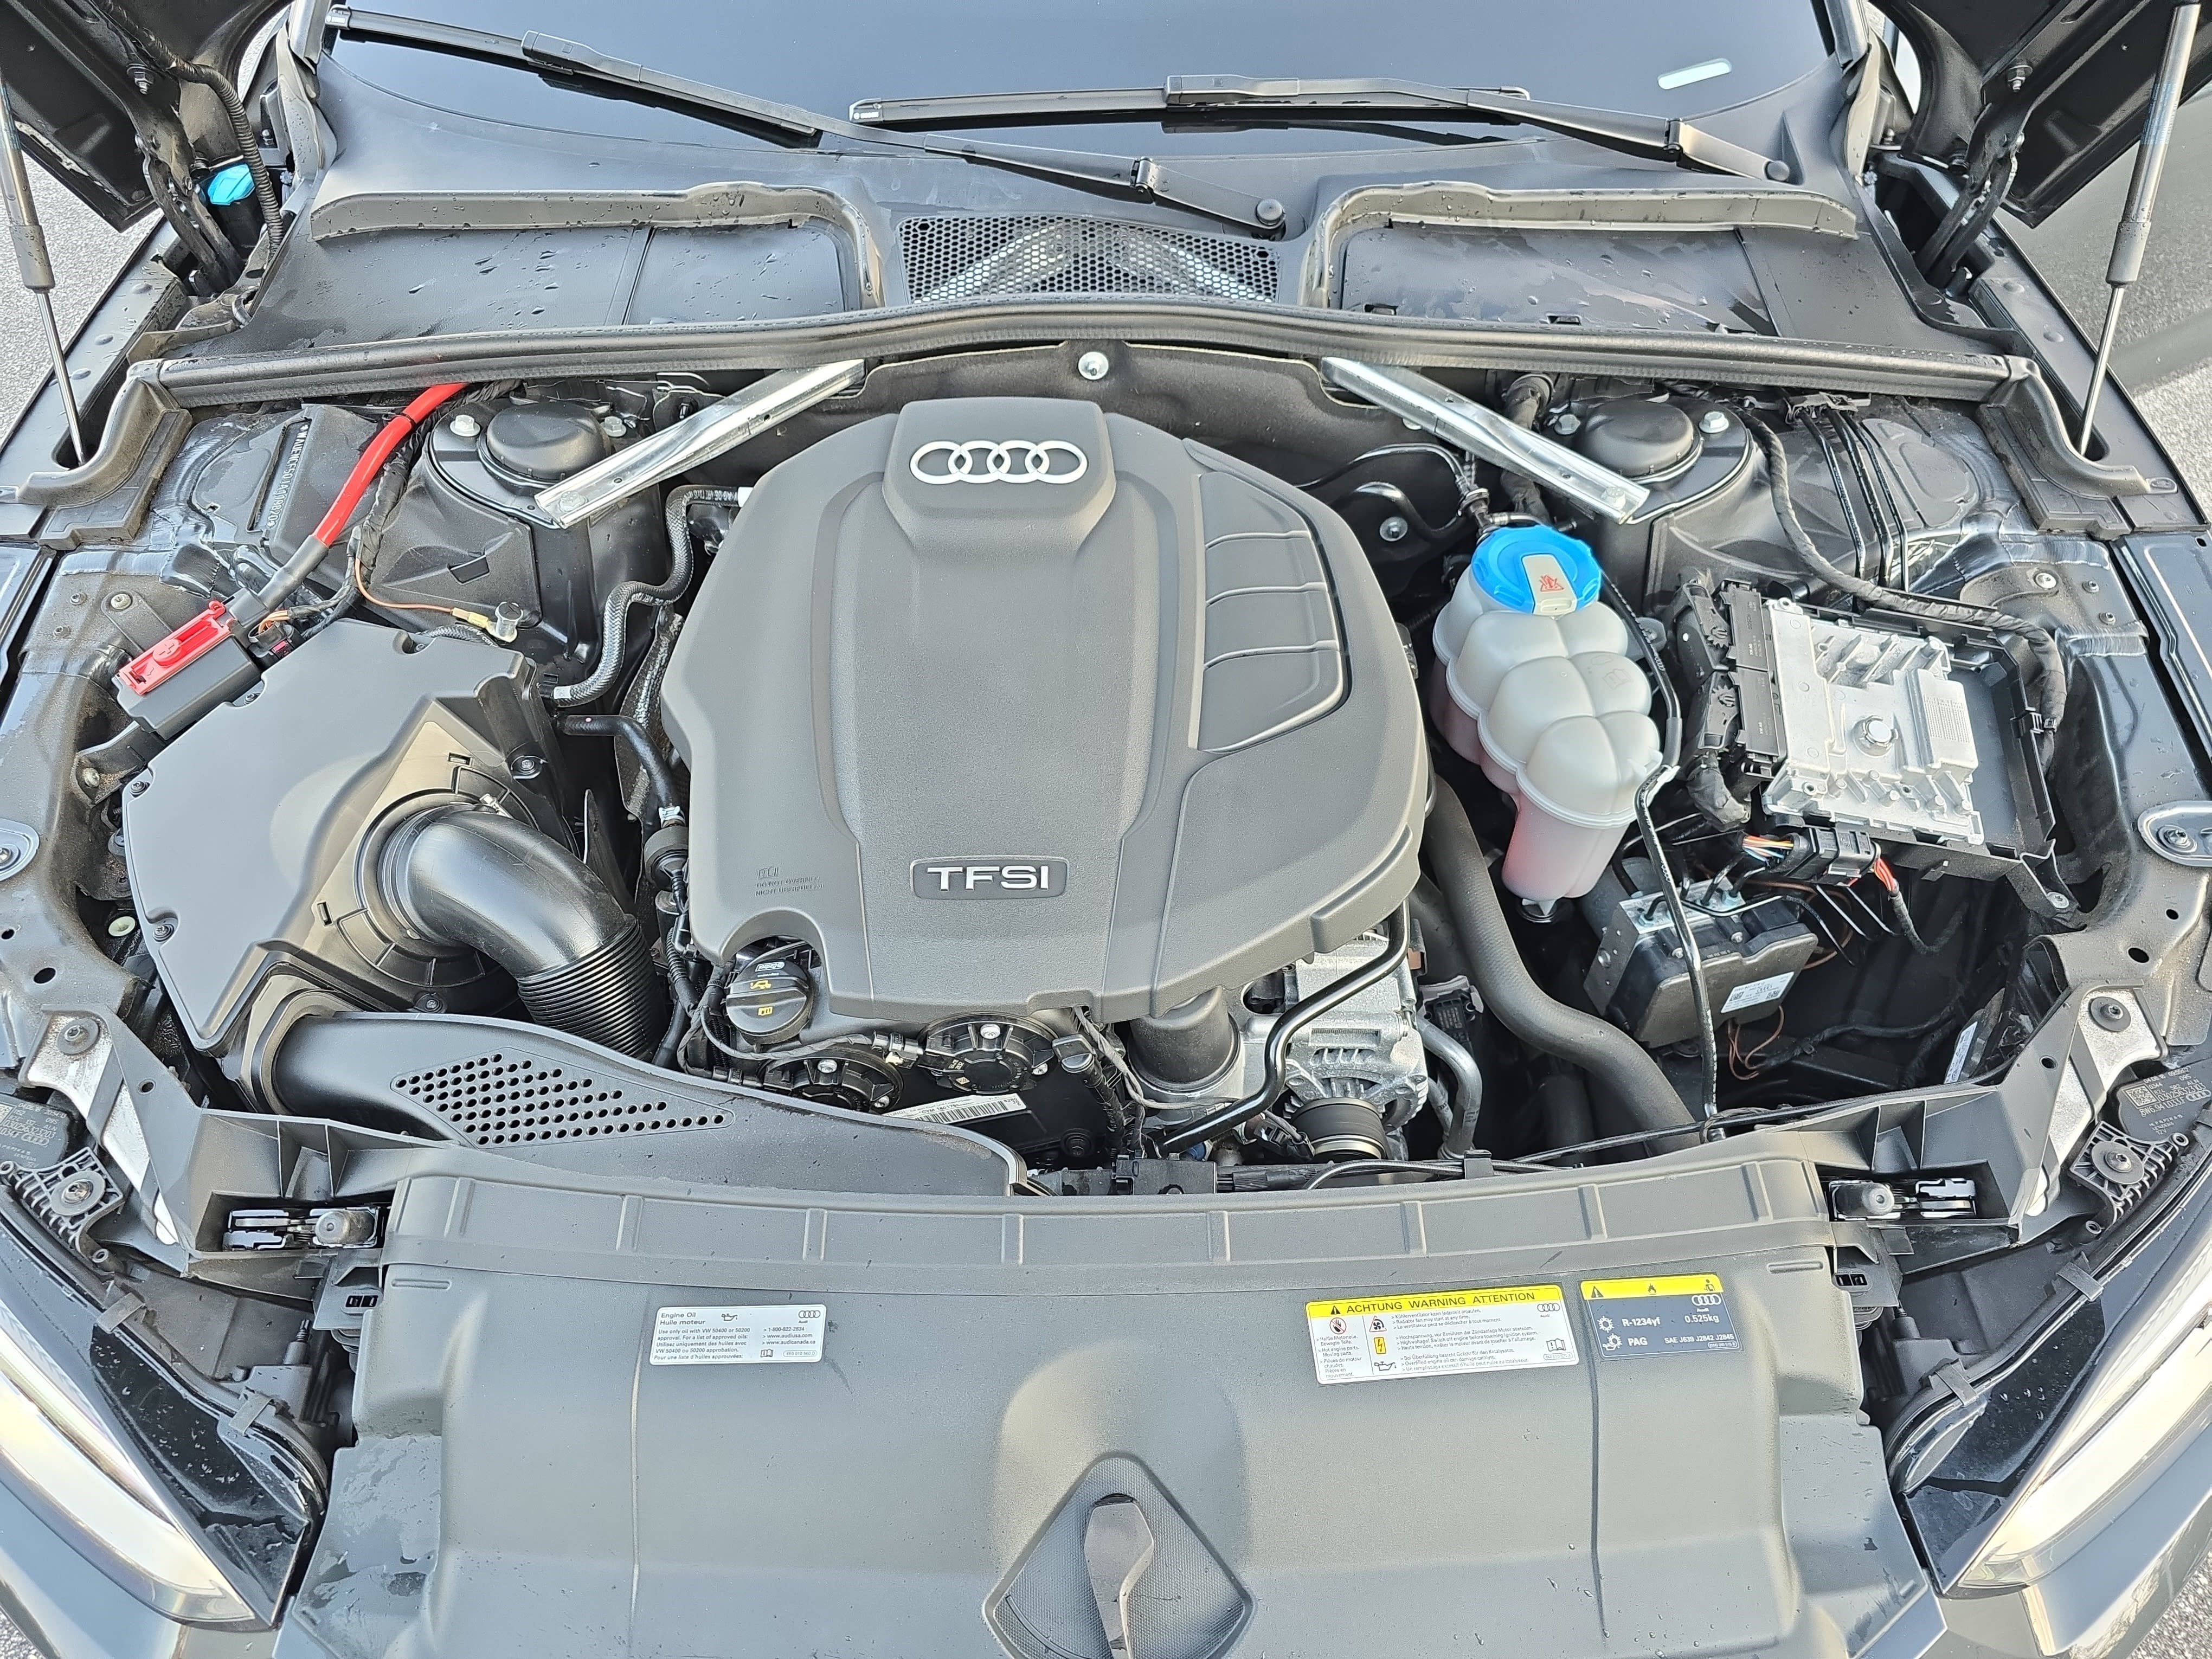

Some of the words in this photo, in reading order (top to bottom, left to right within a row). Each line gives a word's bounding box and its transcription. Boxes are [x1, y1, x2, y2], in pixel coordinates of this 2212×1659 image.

[927, 865, 1049, 891] TFSI
[755, 888, 776, 896] NICHT
[1347, 1302, 1402, 1314] ACHTUNG
[1409, 1297, 1465, 1308] WARNING
[1472, 1293, 1535, 1304] ATTENTION
[1622, 1316, 1661, 1327] R-1234yf
[1684, 1314, 1720, 1323] 0.525kg
[1627, 1337, 1648, 1346] PAG
